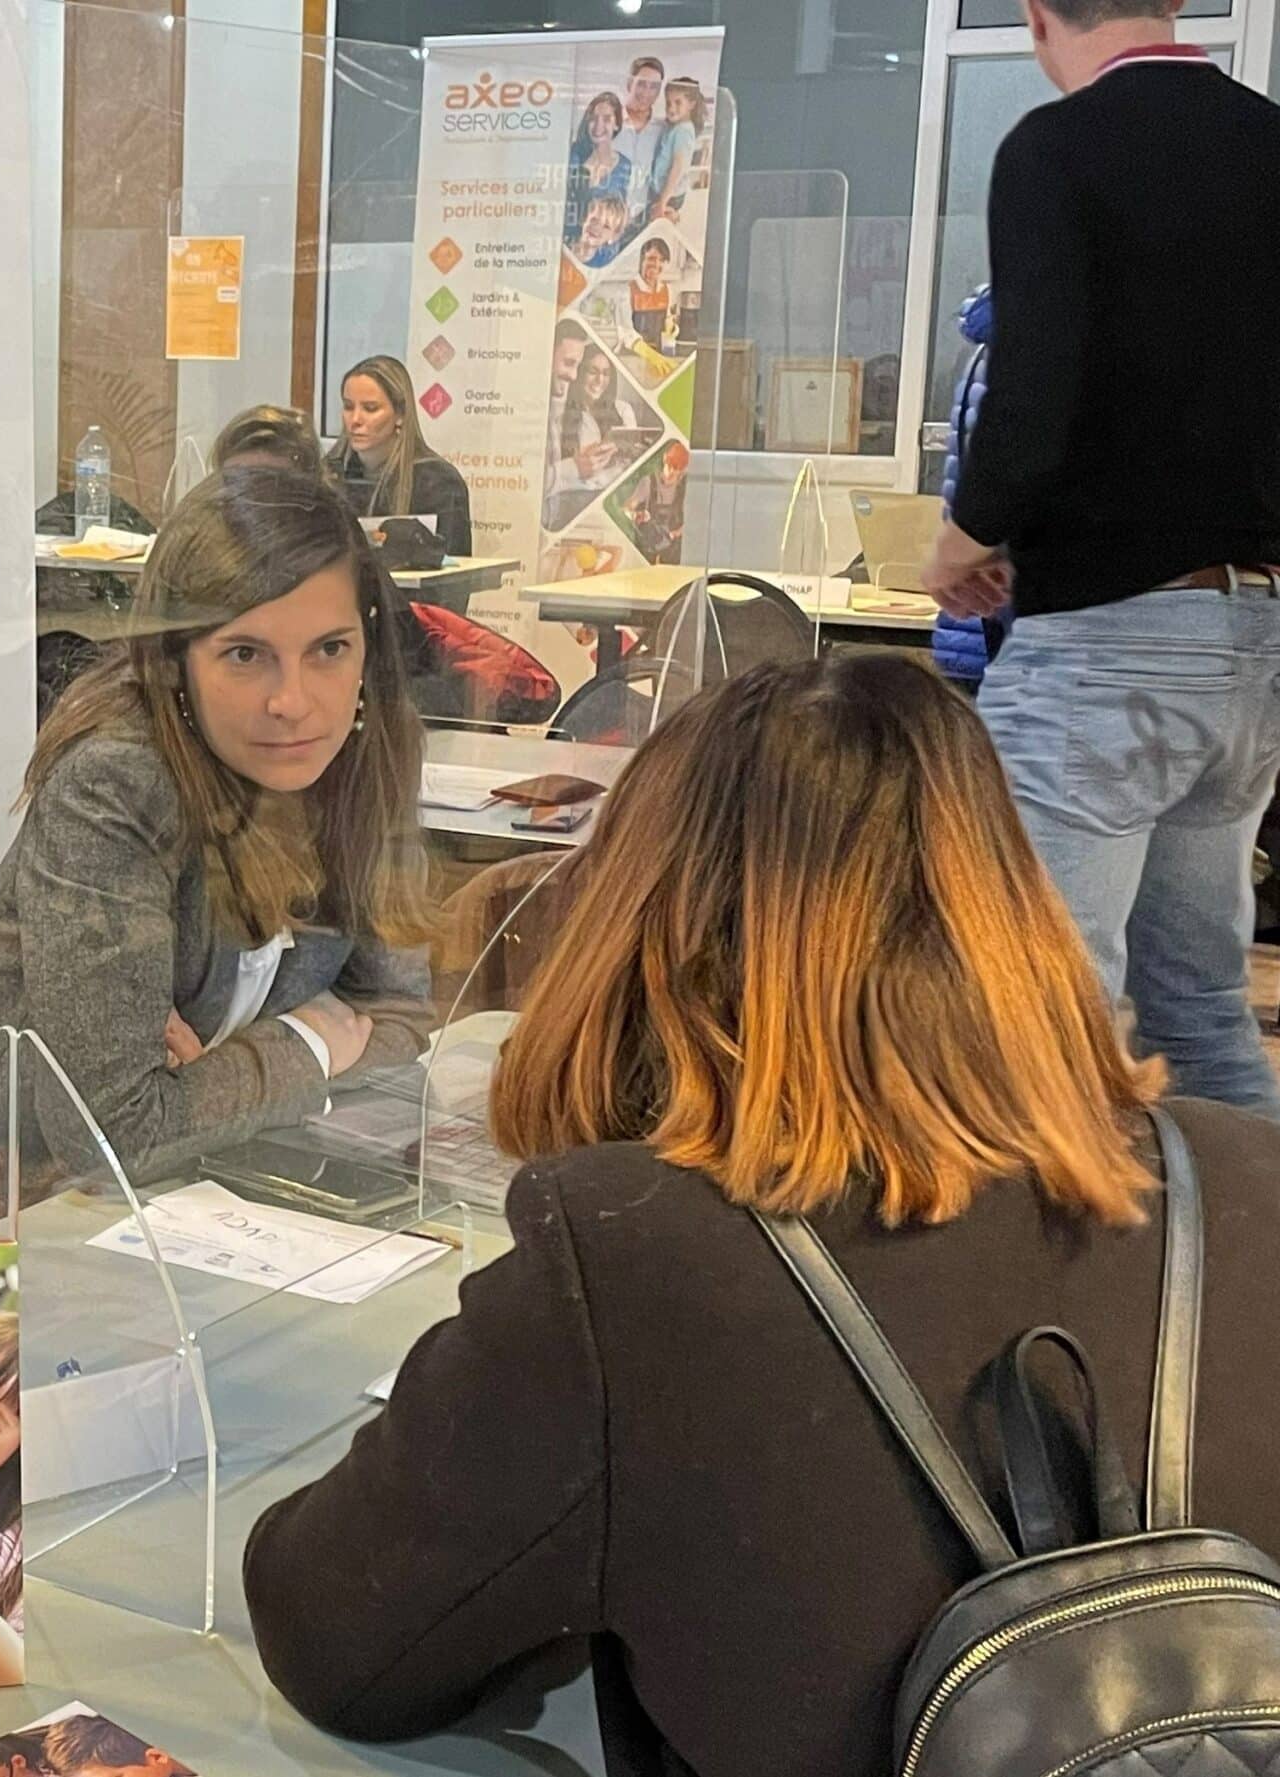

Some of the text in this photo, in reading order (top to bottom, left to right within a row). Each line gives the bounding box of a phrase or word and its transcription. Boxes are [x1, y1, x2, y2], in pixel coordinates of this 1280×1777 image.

[440, 180, 545, 196] Services aux
[442, 202, 537, 222] particuliers
[475, 242, 525, 254] Entretien
[474, 257, 547, 268] de la maison
[467, 348, 521, 361] Bricolage
[464, 389, 501, 401] Garde
